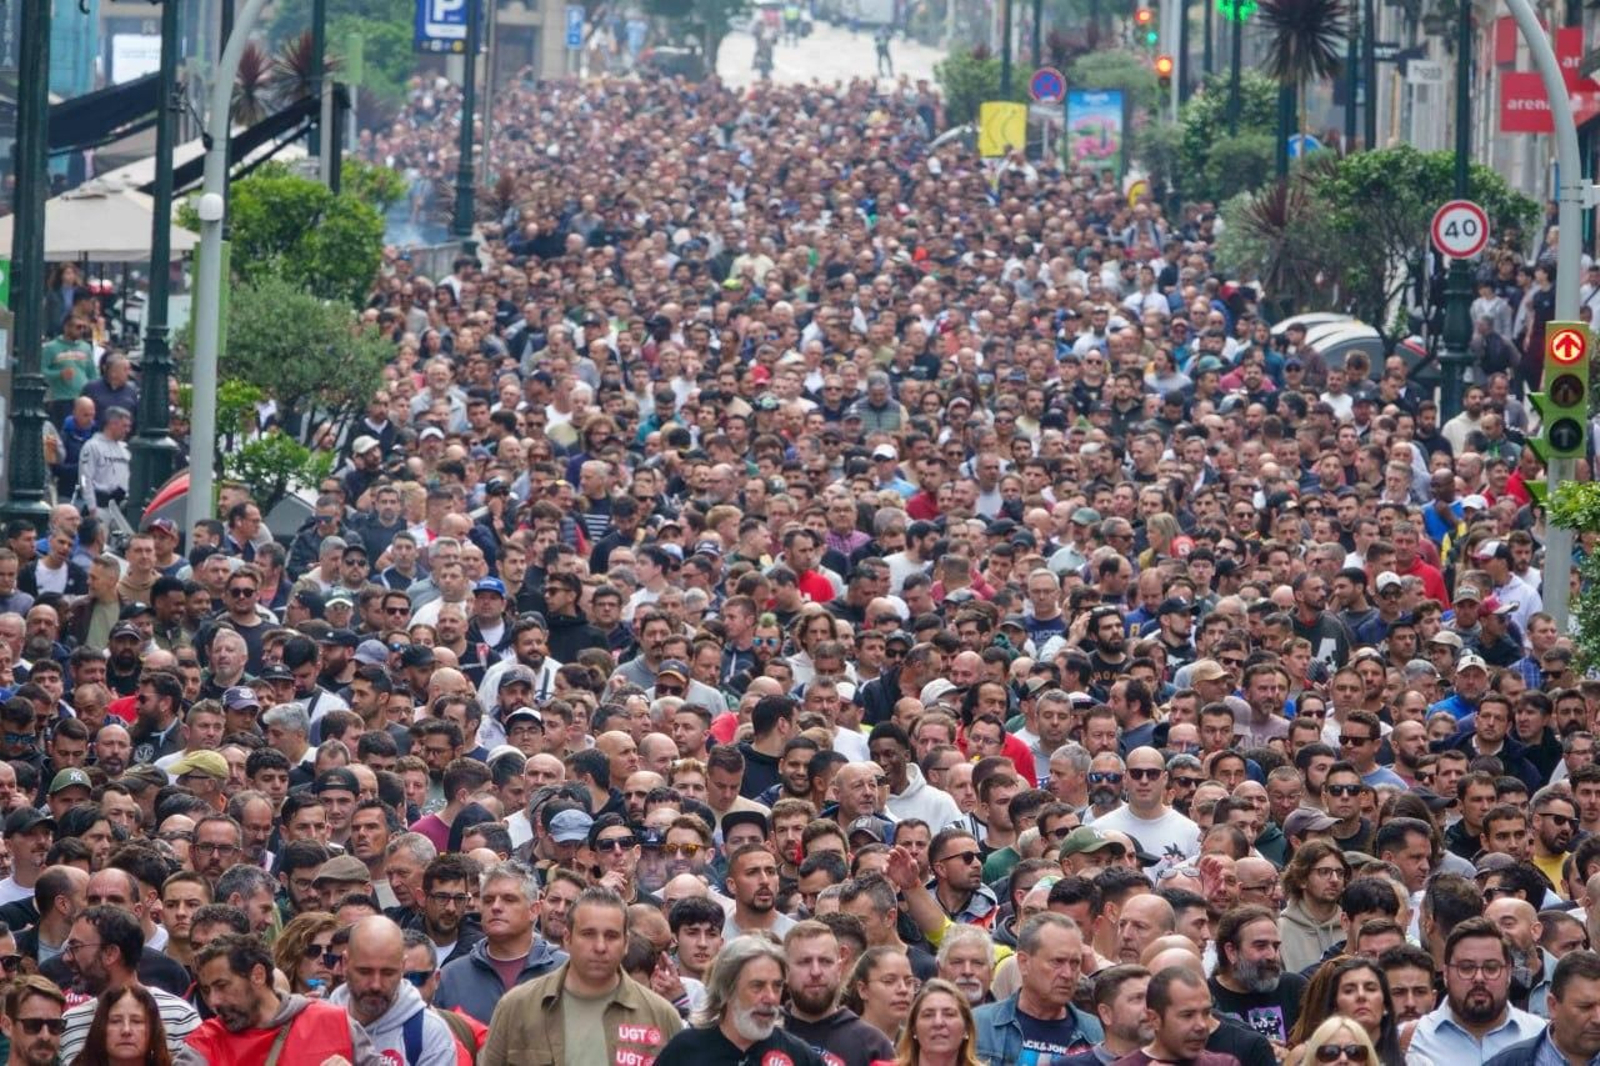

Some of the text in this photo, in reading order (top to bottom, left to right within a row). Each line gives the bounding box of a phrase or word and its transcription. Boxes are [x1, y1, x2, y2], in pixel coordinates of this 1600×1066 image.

[1445, 219, 1477, 238] 40
[619, 1026, 647, 1042] UGT
[616, 1050, 644, 1066] UGT
